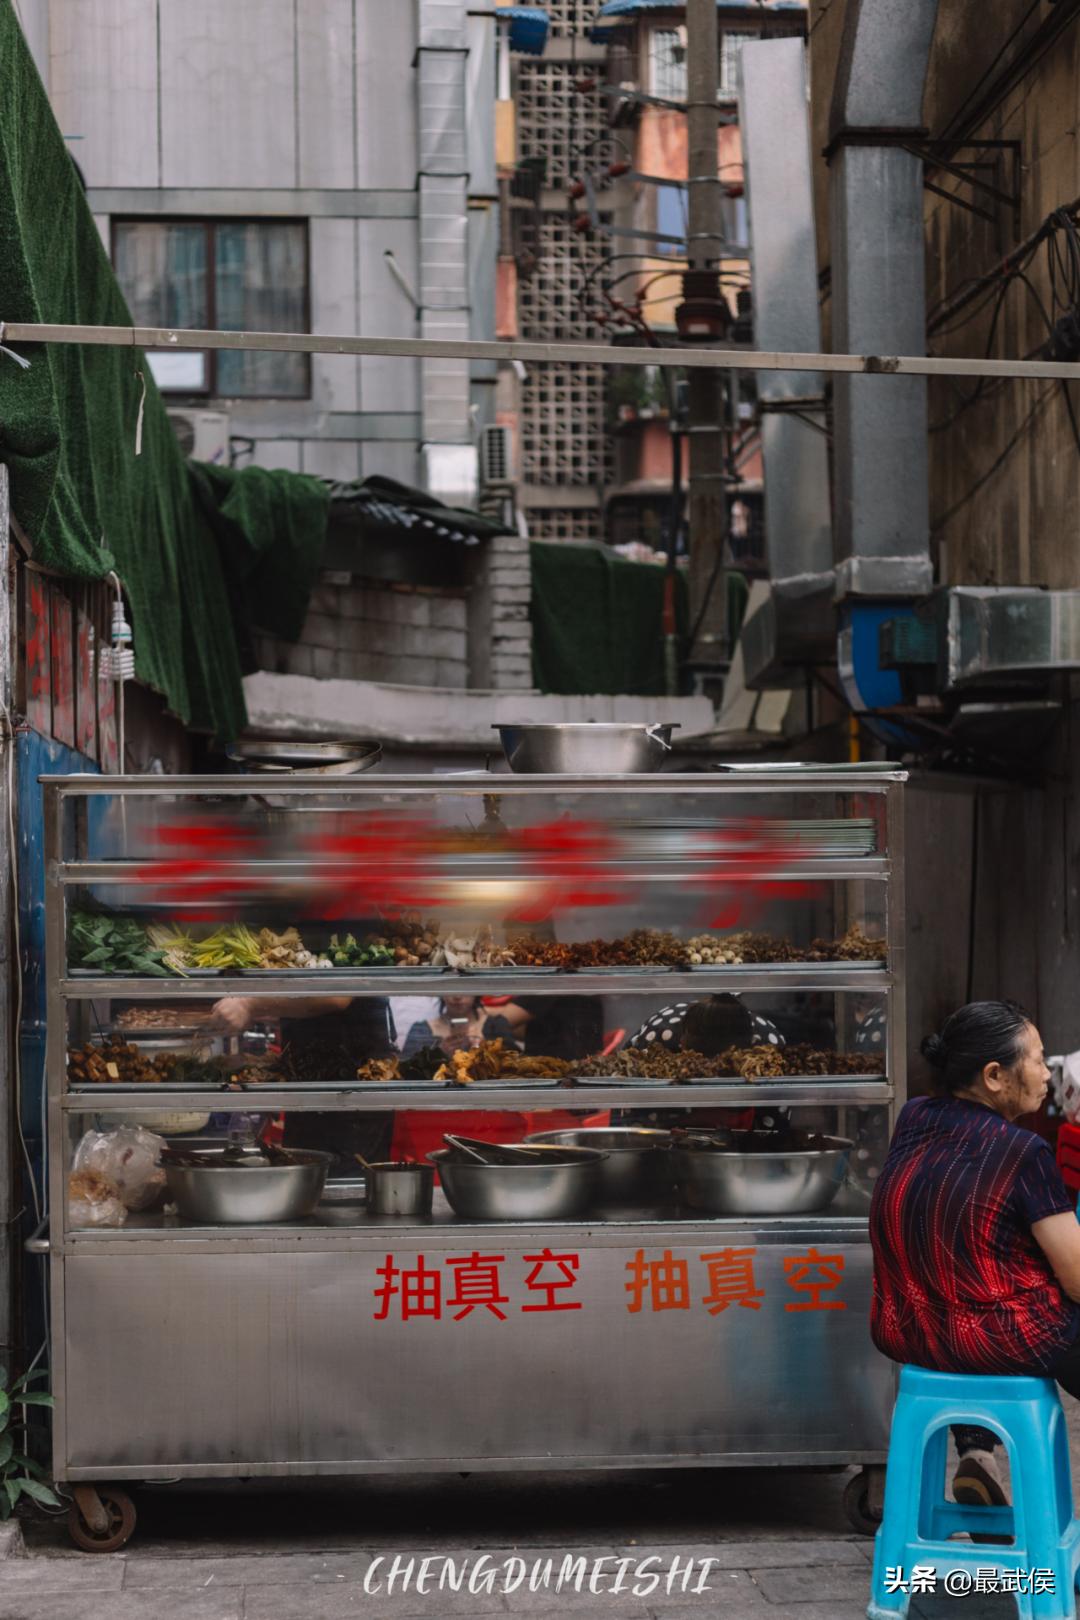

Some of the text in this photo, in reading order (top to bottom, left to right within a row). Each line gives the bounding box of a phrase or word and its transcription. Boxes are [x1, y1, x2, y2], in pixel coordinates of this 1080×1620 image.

[373, 1247, 847, 1321] 抽真空 抽真空
